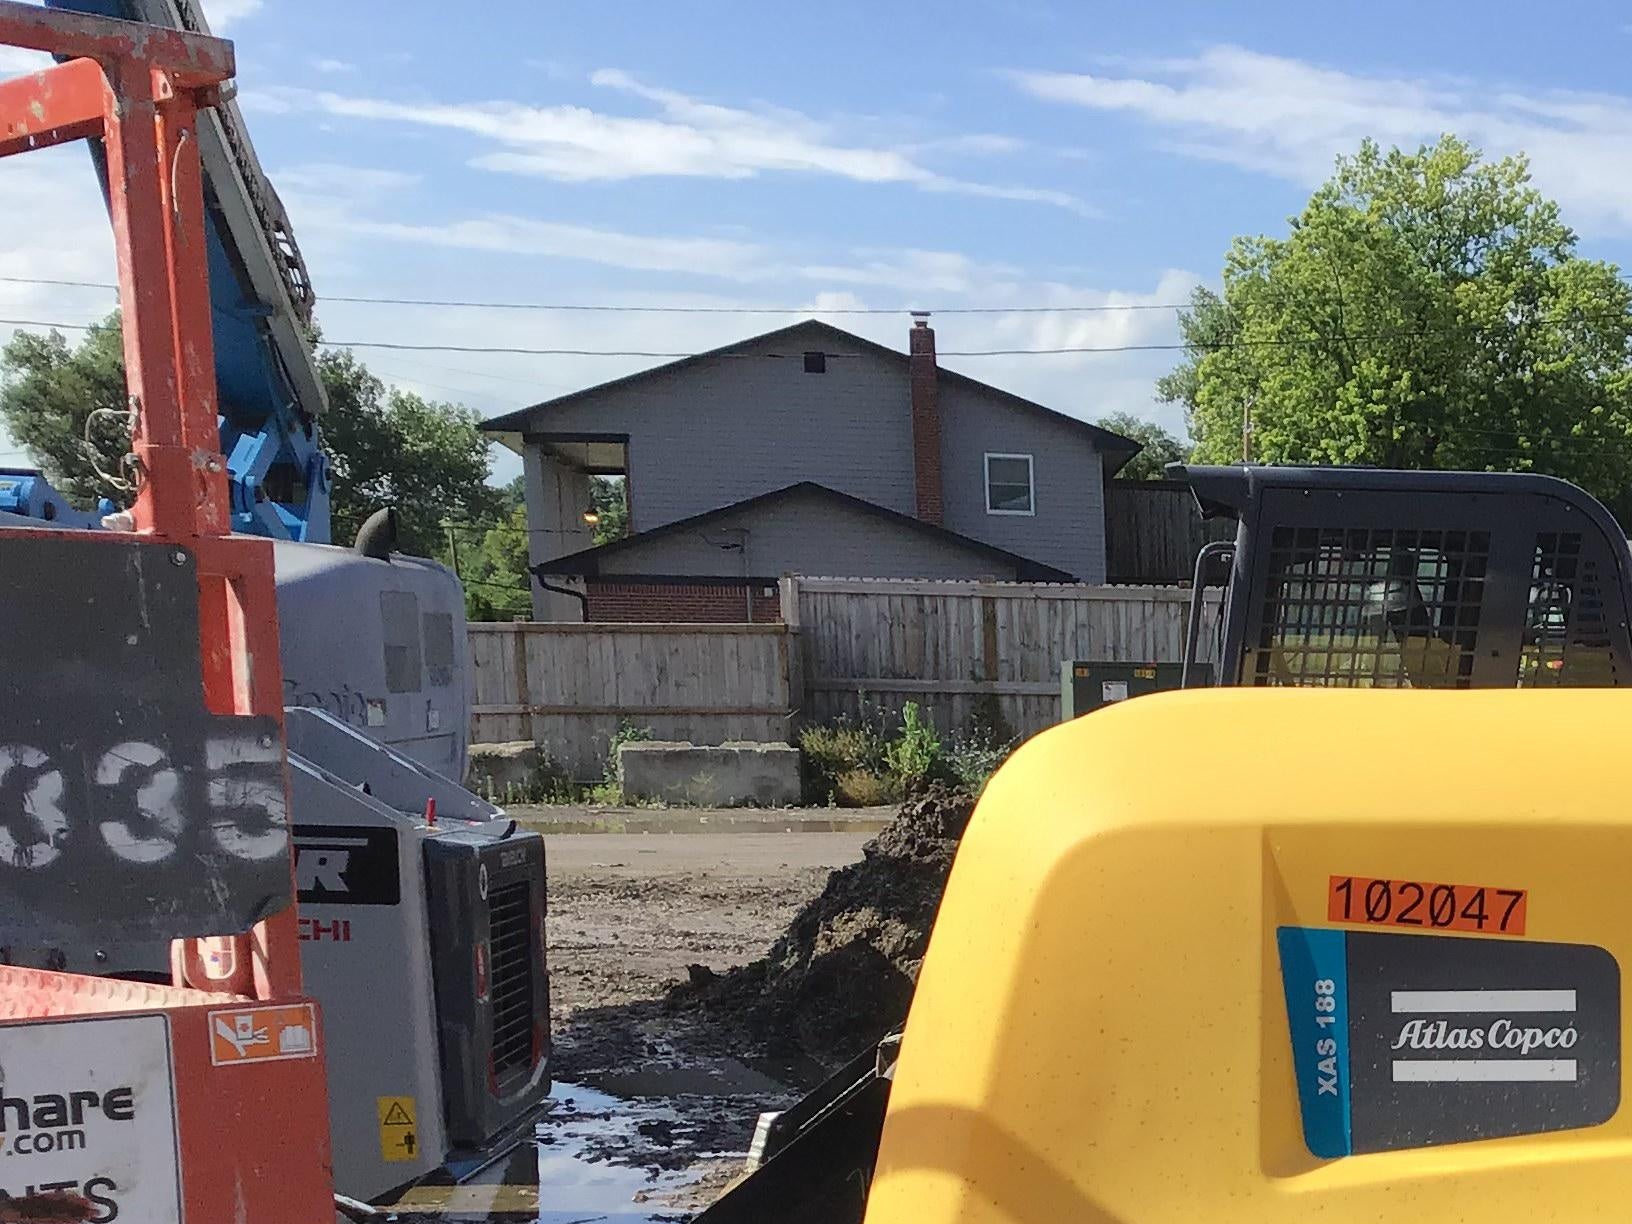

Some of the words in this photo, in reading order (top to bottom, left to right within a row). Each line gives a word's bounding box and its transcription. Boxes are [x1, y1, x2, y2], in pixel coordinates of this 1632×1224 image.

[1334, 879, 1523, 931] 102047
[1315, 978, 1336, 1030] 188
[1391, 1020, 1485, 1050] Atlas
[1487, 1019, 1577, 1055] Copco
[1317, 1037, 1338, 1097] XAS
